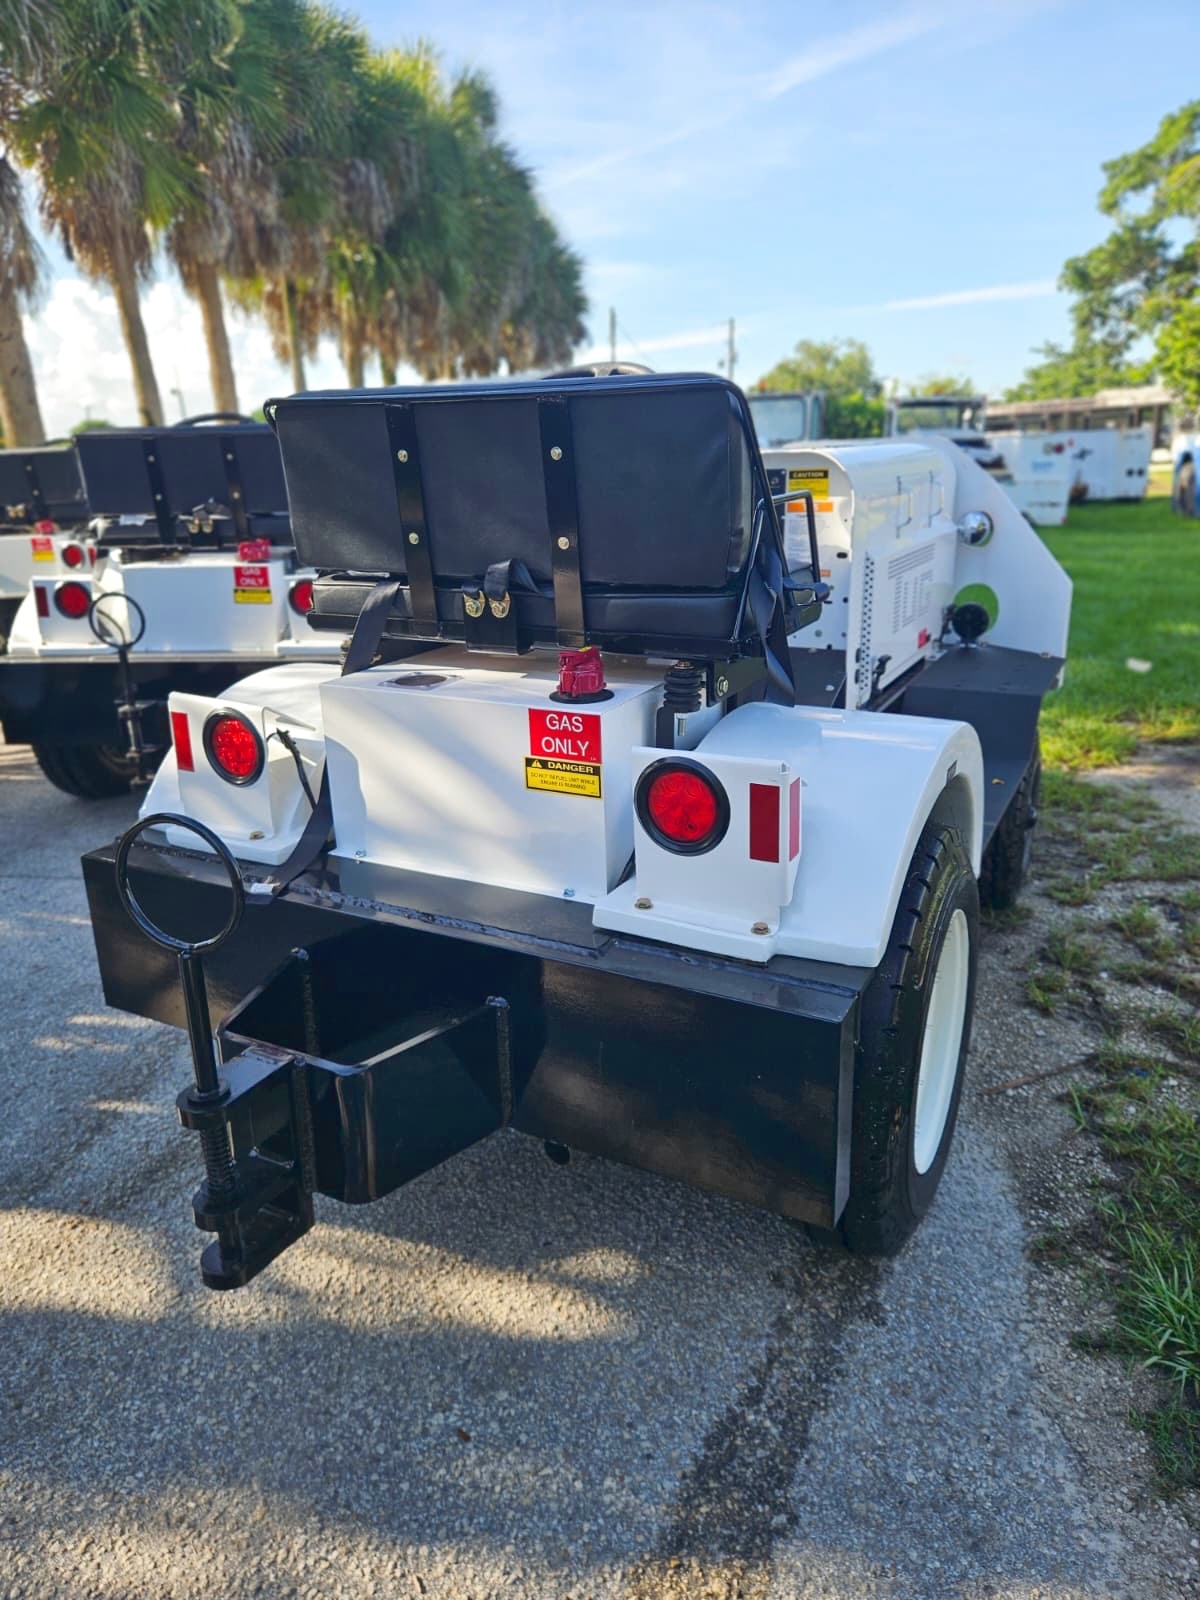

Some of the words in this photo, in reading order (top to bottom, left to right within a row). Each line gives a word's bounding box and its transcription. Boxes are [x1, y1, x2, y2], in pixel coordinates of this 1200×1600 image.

[546, 713, 583, 733] GAS
[541, 736, 589, 757] ONLY
[547, 761, 594, 774] DANGER
